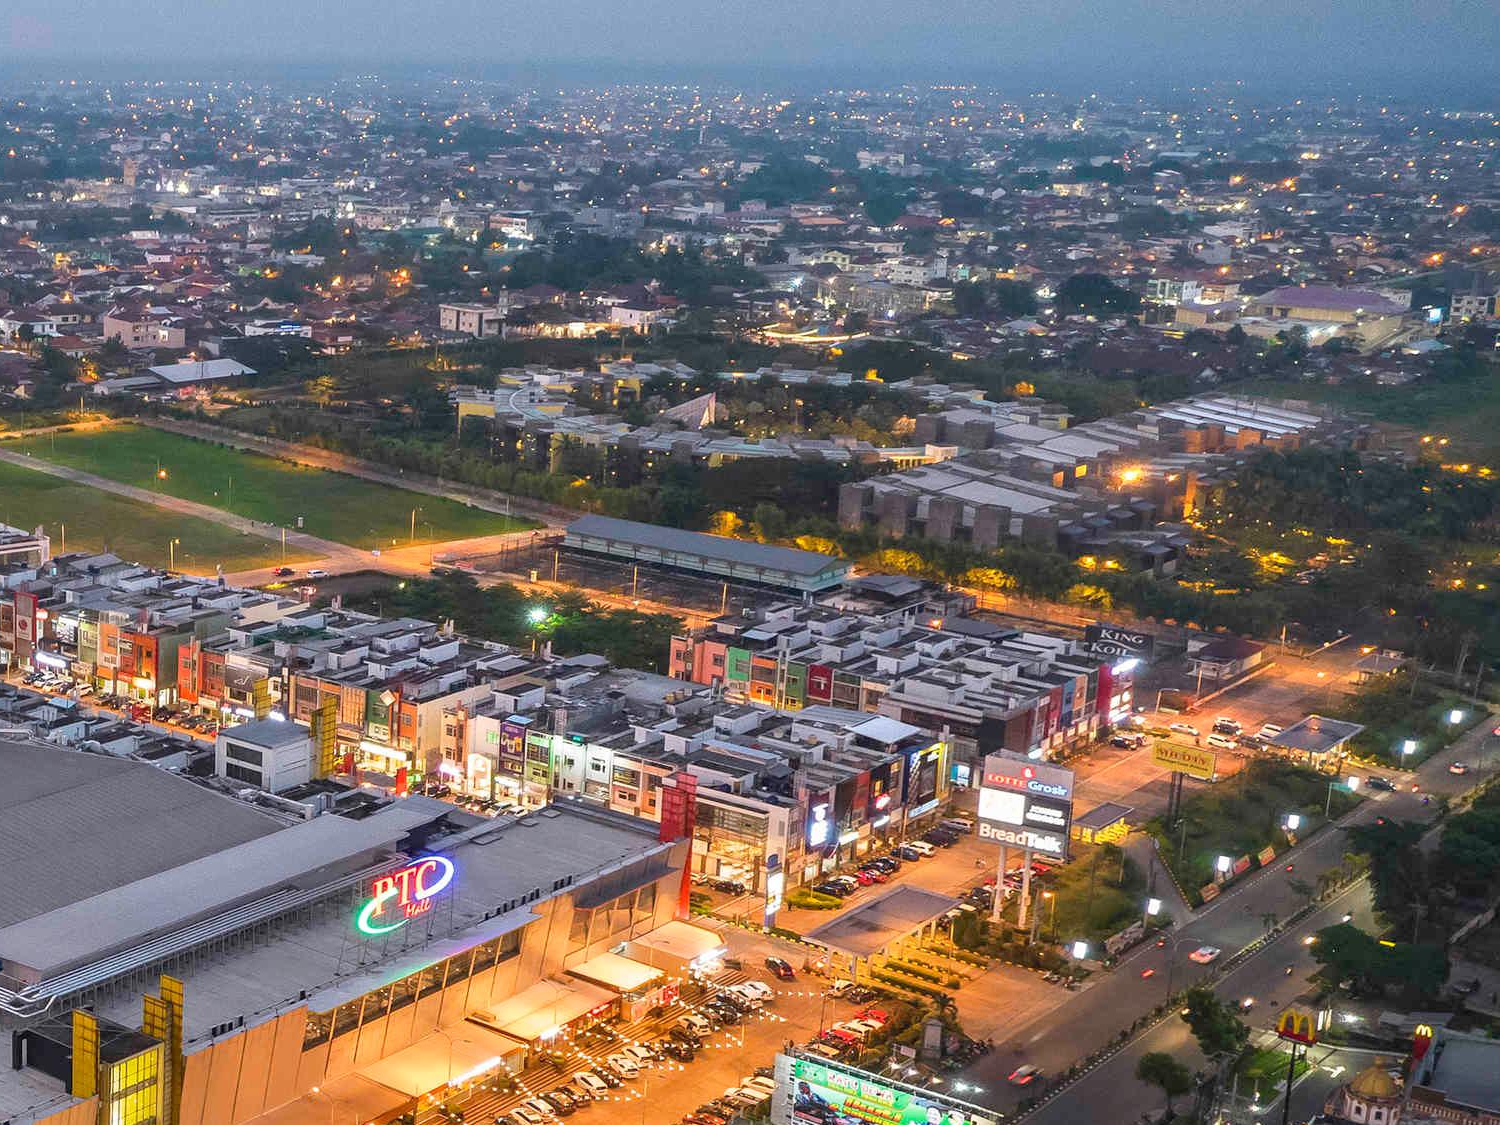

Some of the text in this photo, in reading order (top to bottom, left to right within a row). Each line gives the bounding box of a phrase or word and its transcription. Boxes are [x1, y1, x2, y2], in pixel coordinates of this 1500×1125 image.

[1100, 628, 1144, 644] KING
[1090, 642, 1135, 658] KOIL
[987, 773, 1068, 796] LOTTE Grosir
[979, 822, 1062, 853] BreadTalk
[373, 860, 437, 918] PTC
[404, 898, 431, 919] Mall
